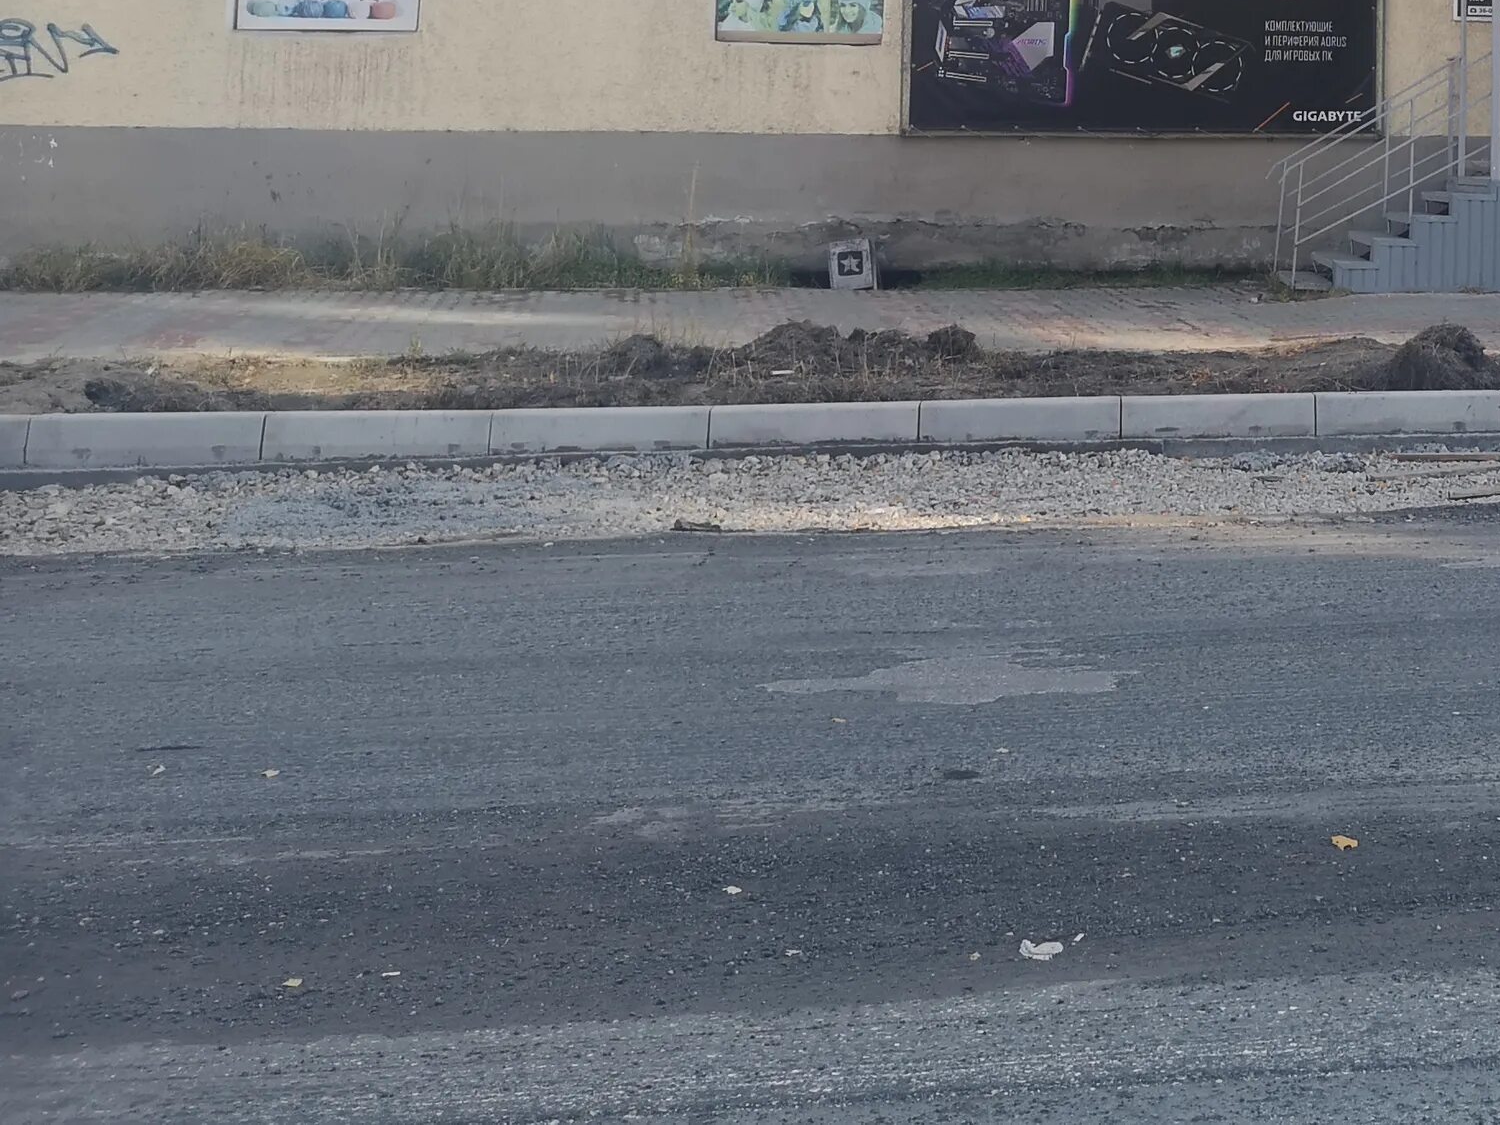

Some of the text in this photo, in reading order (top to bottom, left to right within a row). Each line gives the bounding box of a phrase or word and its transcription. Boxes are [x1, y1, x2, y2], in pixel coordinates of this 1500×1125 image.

[1264, 20, 1333, 33] КОМПЛЕКТУЮЩИЕ
[1264, 35, 1347, 48] И ПЕРИФЕРИЯ AORUS
[1264, 49, 1333, 62] ДЛЯ ИГРОВЫХ ПК
[1293, 110, 1363, 123] GIGABYTE
